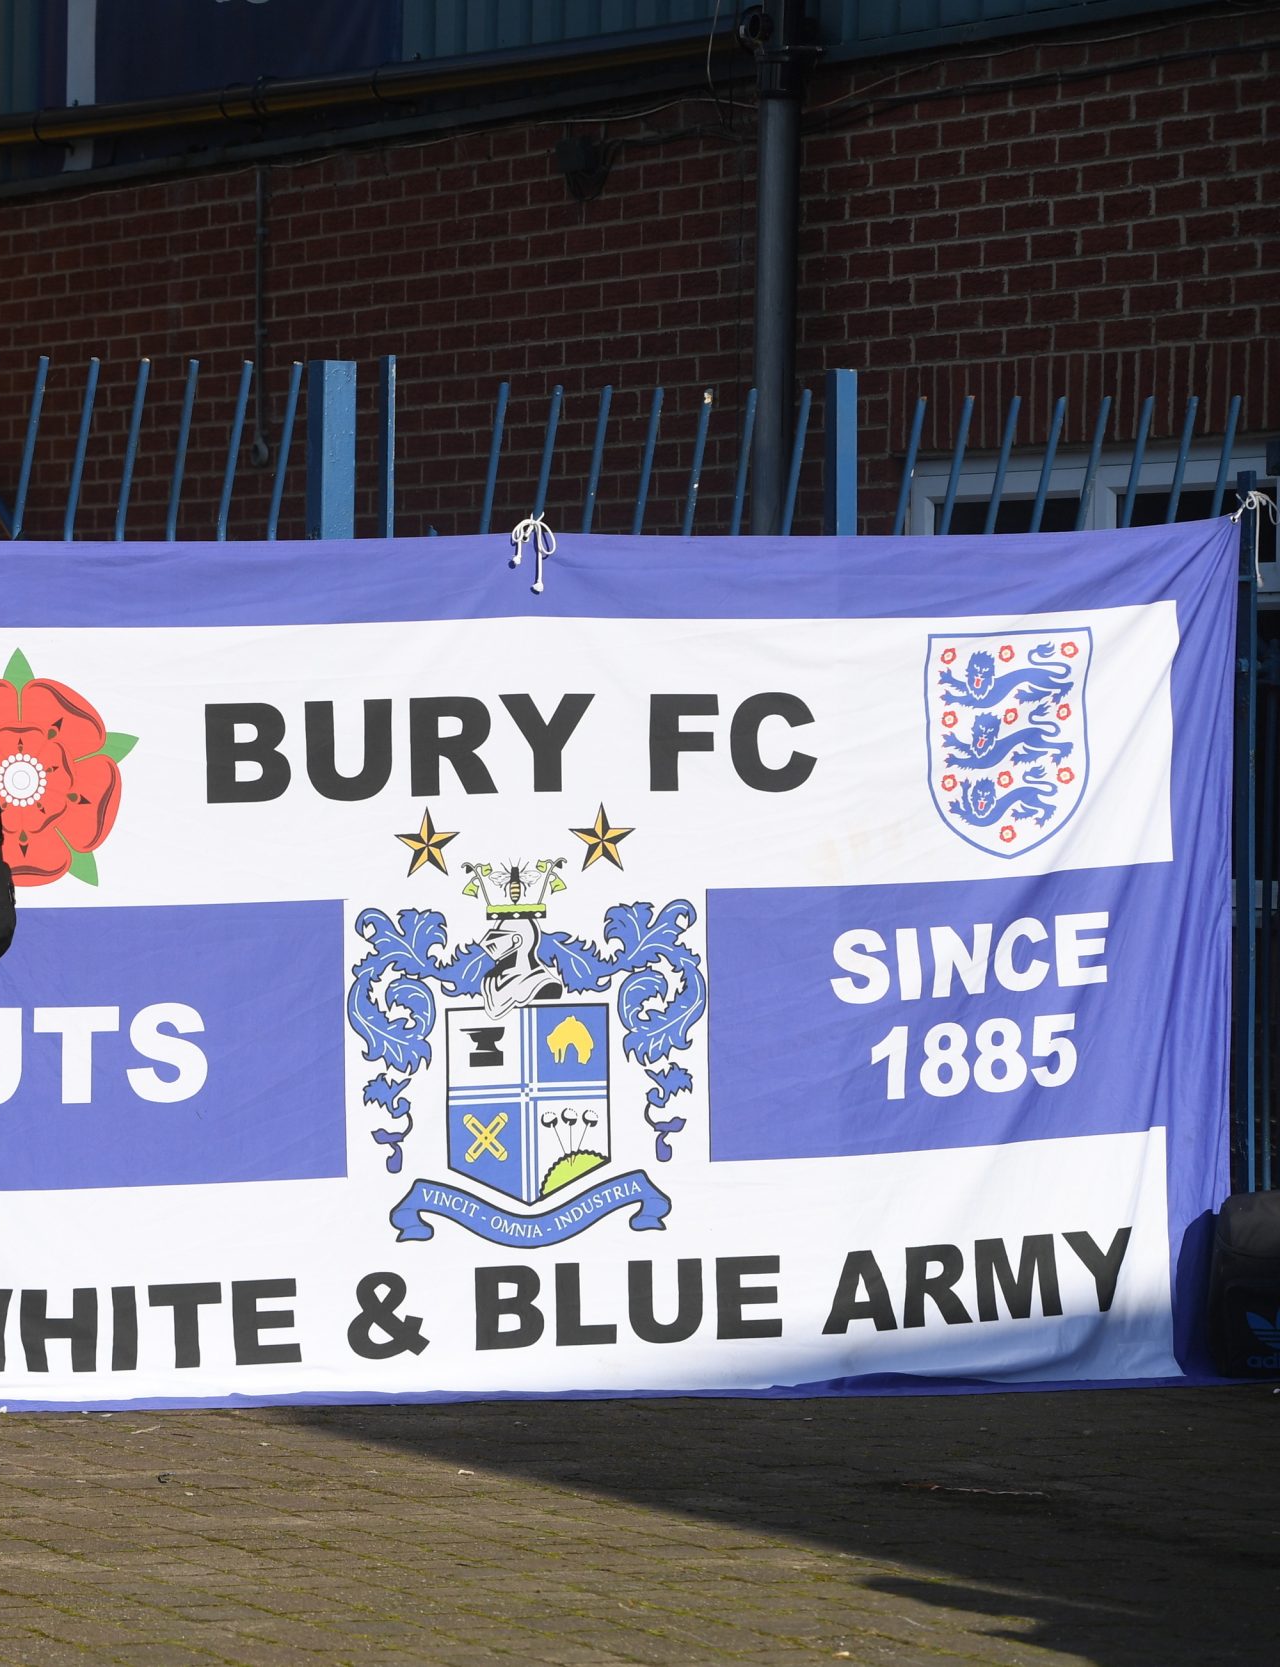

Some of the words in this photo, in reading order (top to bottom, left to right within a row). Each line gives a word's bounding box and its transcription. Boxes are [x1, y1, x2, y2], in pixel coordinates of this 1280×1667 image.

[205, 693, 596, 804] BURY
[649, 692, 818, 792] FC
[830, 911, 1109, 1004] SINCE
[871, 1013, 1077, 1100] 1885
[422, 1188, 480, 1218] VINCIT
[490, 1215, 543, 1239] OMNIA
[555, 1180, 642, 1231] INDUSTRIA
[347, 1271, 430, 1359] &
[475, 1255, 783, 1351] BLUE
[821, 1226, 1132, 1335] ARMY
